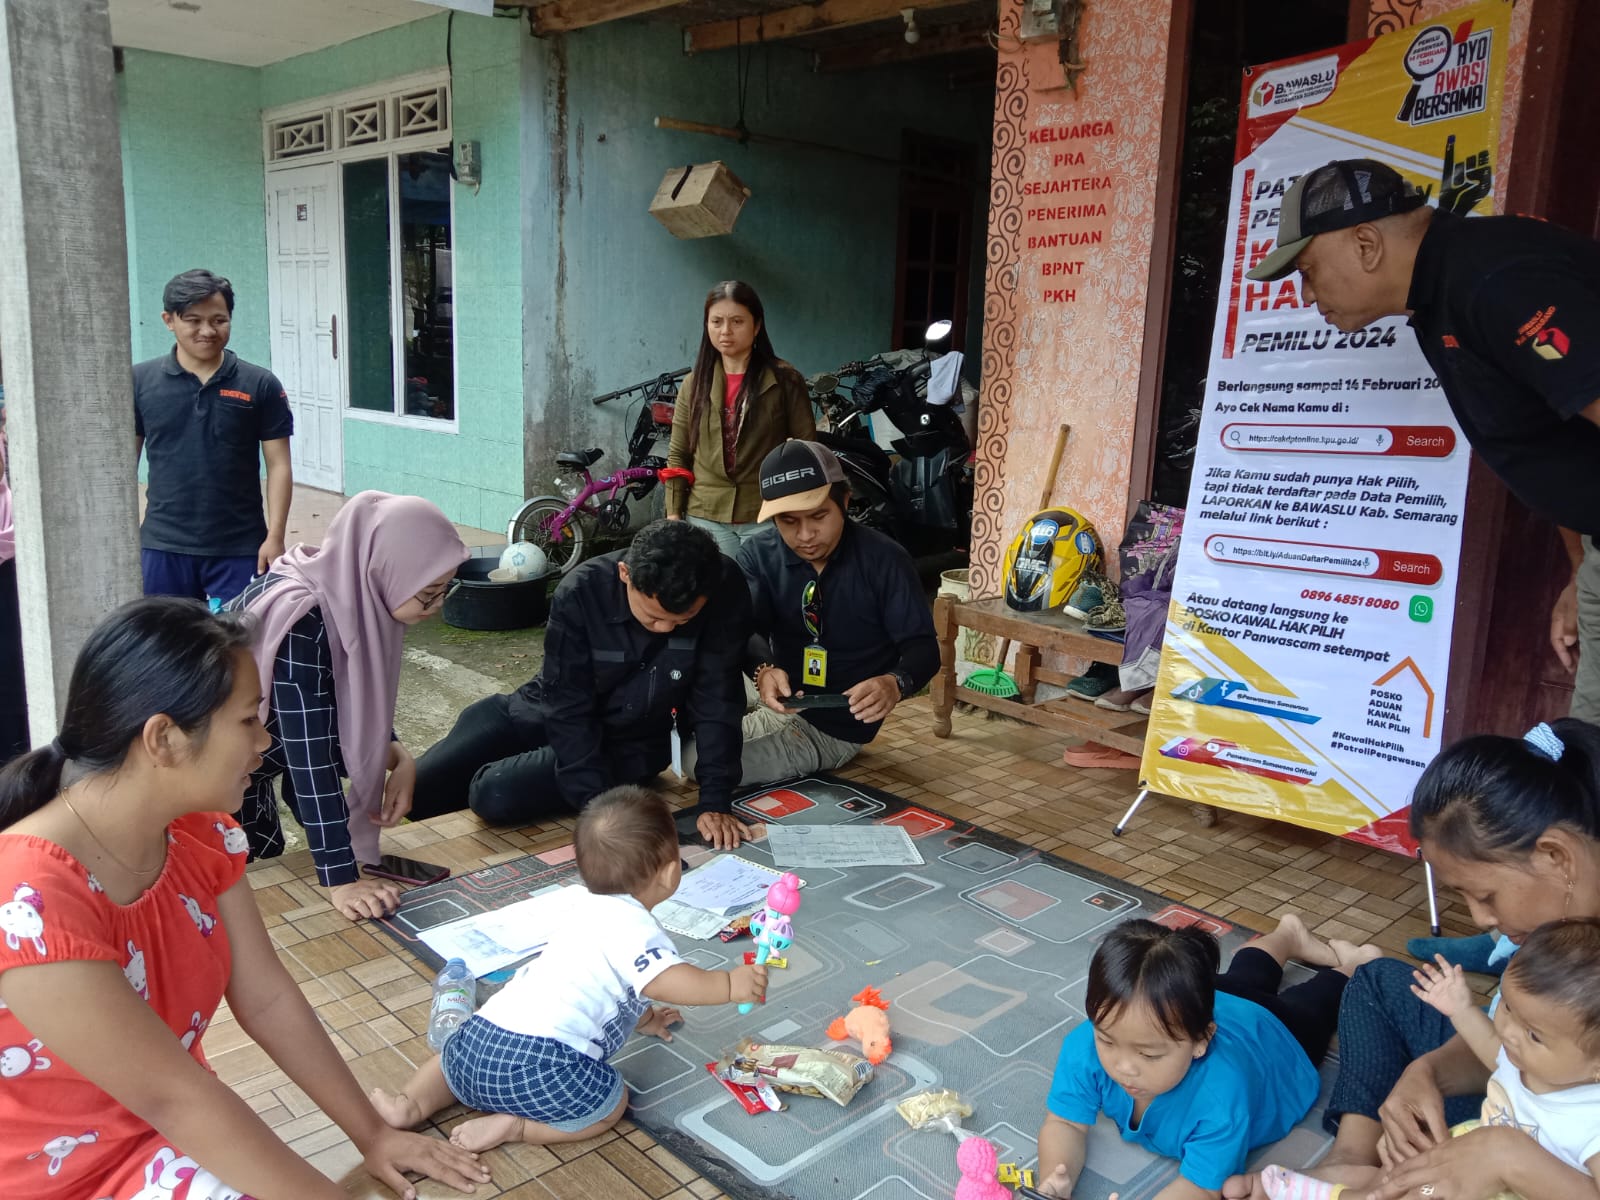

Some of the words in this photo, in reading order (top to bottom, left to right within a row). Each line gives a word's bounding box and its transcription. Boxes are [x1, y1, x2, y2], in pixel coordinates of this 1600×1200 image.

[1457, 36, 1487, 66] AYO
[1275, 69, 1335, 94] BAWASLU
[1434, 60, 1485, 95] AWASI
[1414, 84, 1483, 121] BERSAMA
[1029, 121, 1114, 144] KELUARGA
[1054, 151, 1085, 167] PRA
[1024, 176, 1112, 196] SEJAHTERA
[1027, 203, 1107, 222] PENERIMA
[1028, 230, 1102, 249] BANTUAN
[1042, 261, 1085, 276] BPNT
[1043, 289, 1076, 303] PKH
[1245, 280, 1312, 312] HA
[1241, 330, 1332, 353] PEMILU
[1334, 326, 1396, 348] 2024
[1217, 380, 1294, 394] Berlangsung
[1296, 378, 1343, 393] sampai
[1345, 379, 1359, 391] 14
[1362, 377, 1421, 391] Februari
[1424, 377, 1440, 390] 20
[1215, 402, 1237, 414] Ayo
[1240, 402, 1260, 413] Cek
[1263, 402, 1295, 413] Nama
[1298, 402, 1329, 413] Kamu
[1332, 402, 1343, 413] di
[1406, 435, 1445, 447] Search
[762, 466, 816, 489] EIGER
[1205, 467, 1231, 479] Jika
[1234, 469, 1271, 481] Kamu
[1273, 472, 1310, 483] sudah
[1313, 475, 1353, 487] punya
[1356, 475, 1383, 487] Hak
[1386, 476, 1420, 491] Pilih,
[1204, 481, 1228, 494] tapi
[1232, 483, 1264, 495] tidak
[1266, 485, 1323, 499] terdaftar
[1323, 489, 1356, 501] pada
[1360, 491, 1392, 503] Data
[1395, 493, 1447, 508] Pemilih,
[1200, 510, 1247, 523] melalui
[1249, 512, 1273, 525] link
[1275, 515, 1321, 529] berikut
[1201, 495, 1272, 510] LAPORKAN
[1274, 500, 1290, 512] ke
[1292, 501, 1356, 516] BAWASLU
[1359, 506, 1389, 518] Kab.
[1393, 508, 1458, 526] Semarang
[1393, 560, 1431, 575] Search
[1187, 592, 1220, 606] Atau
[1221, 597, 1268, 615] datang
[1270, 603, 1330, 624] langsung
[1332, 611, 1349, 624] ke
[1300, 589, 1332, 602] 0896
[1334, 593, 1364, 606] 4851
[1365, 597, 1400, 610] 8080
[1184, 606, 1231, 622] POSKO
[1231, 613, 1278, 630] KAWAL
[1279, 620, 1310, 635] HAK
[1310, 624, 1345, 639] PILIH
[1182, 620, 1195, 631] di
[1197, 622, 1241, 639] Kantor
[1242, 629, 1321, 652] Panwascam
[1323, 643, 1391, 662] setempat
[1369, 699, 1402, 712] ADUAN
[1370, 689, 1403, 701] POSKO
[1368, 708, 1401, 721] KAWAL
[1366, 718, 1387, 729] HAK
[1388, 722, 1411, 734] PILIH
[1332, 731, 1405, 752] #KawalHakPilih
[1331, 741, 1426, 768] #PatroliPengawasan
[634, 947, 677, 973] ST
